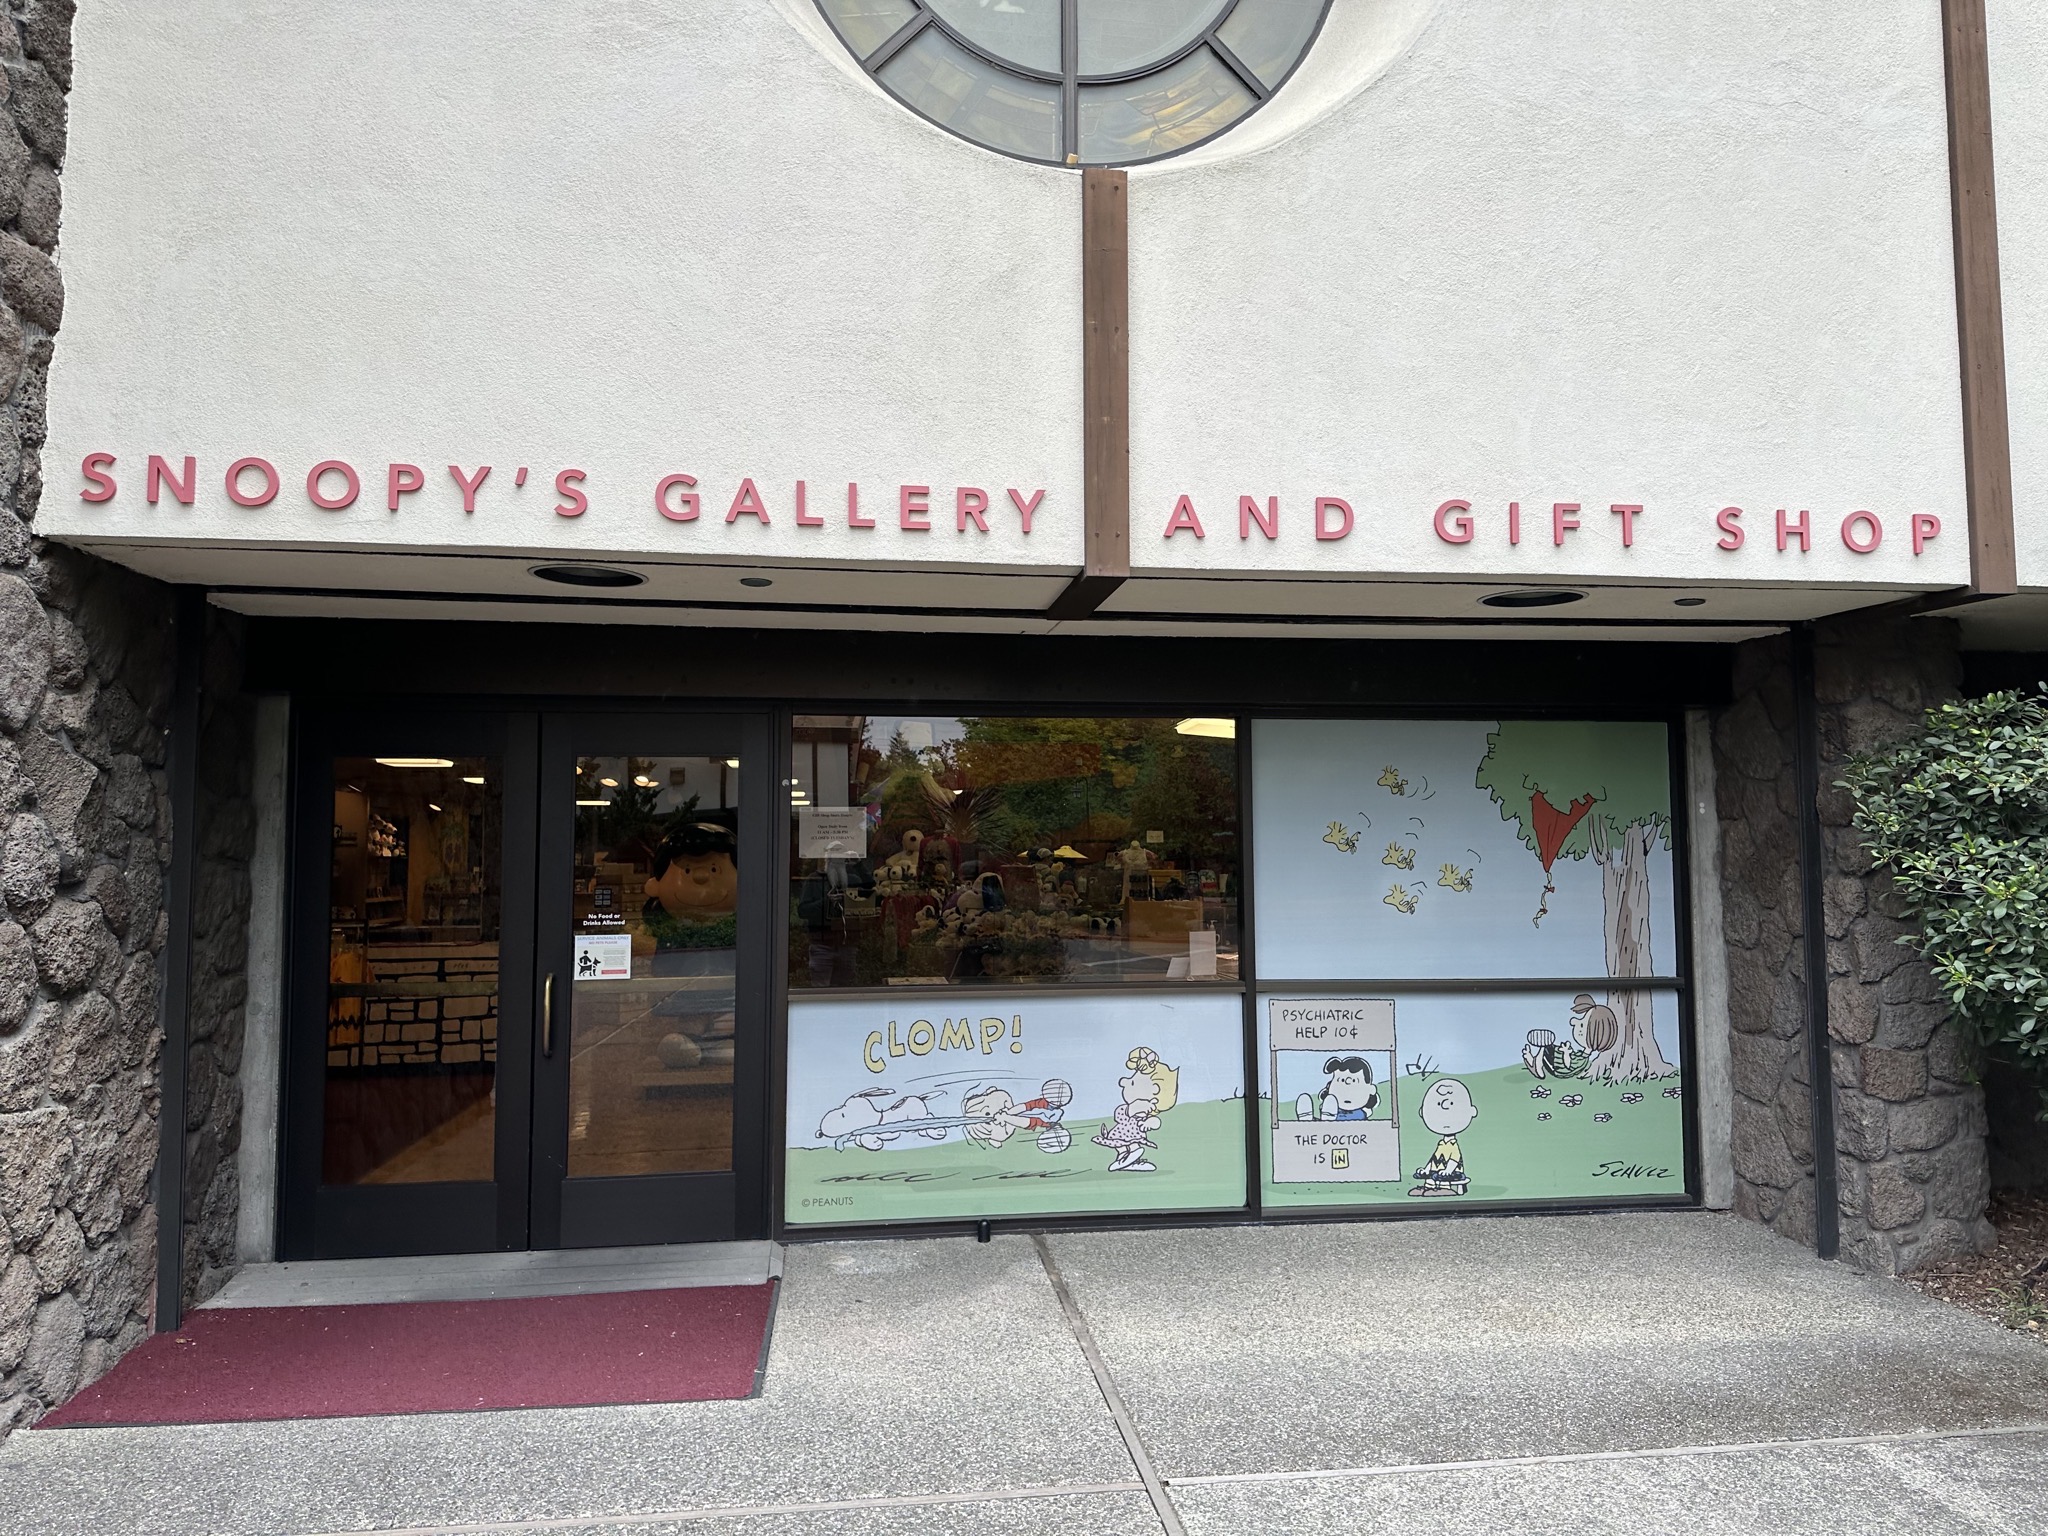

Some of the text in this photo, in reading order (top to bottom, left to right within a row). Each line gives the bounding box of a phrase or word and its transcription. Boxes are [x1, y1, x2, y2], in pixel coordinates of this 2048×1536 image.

[80, 453, 1941, 556] SNOOPY'S GALLERY AND GIFT SHOP
[1282, 1008, 1364, 1022] PSYCHIATRIC
[1295, 1024, 1358, 1040] HELP 10¢
[864, 1014, 1023, 1074] CLOMP!
[1294, 1133, 1367, 1146] THE DOCTOR
[1313, 1152, 1346, 1165] IS IN
[812, 1196, 854, 1207] PEANUTS
